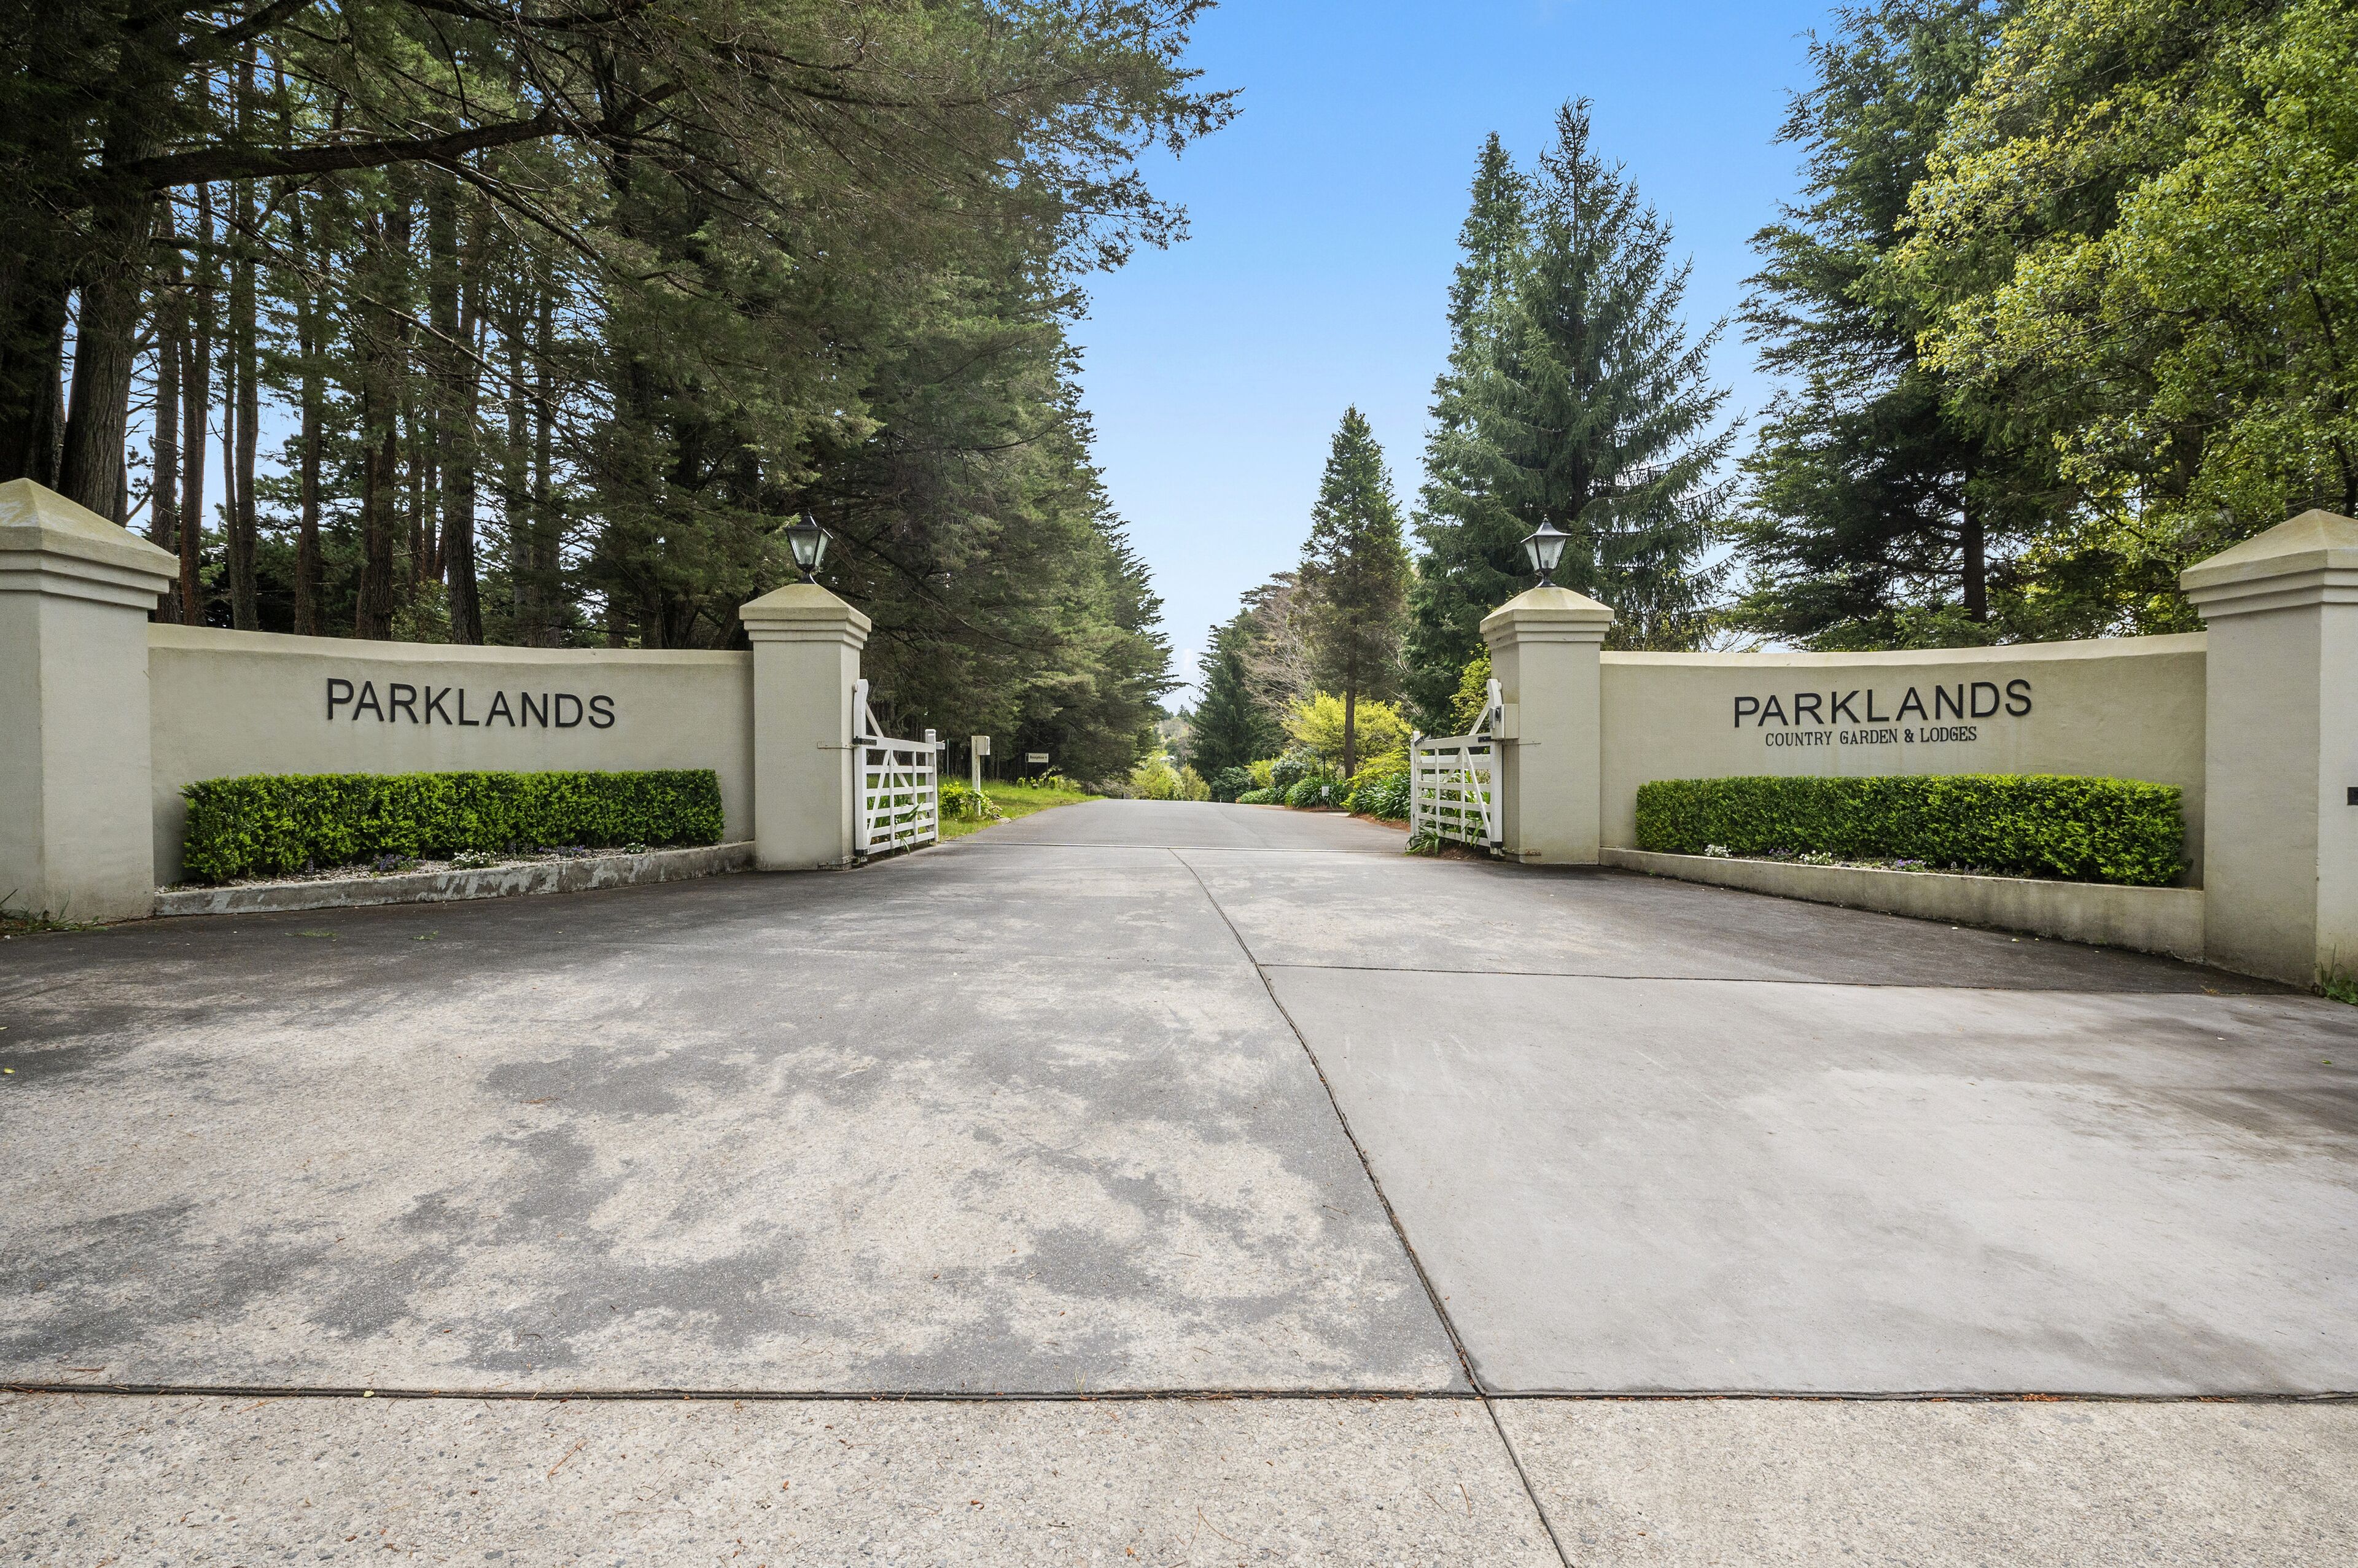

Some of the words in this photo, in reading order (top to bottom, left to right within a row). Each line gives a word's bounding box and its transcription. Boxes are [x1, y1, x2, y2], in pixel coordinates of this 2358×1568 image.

[327, 678, 615, 729] PARKLANDS
[1733, 678, 2032, 728] PARKLANDS
[1765, 731, 1833, 746] COUNTRY
[1840, 729, 1898, 744] GARDEN
[1904, 729, 1915, 743] &
[1920, 726, 1977, 742] LODGES
